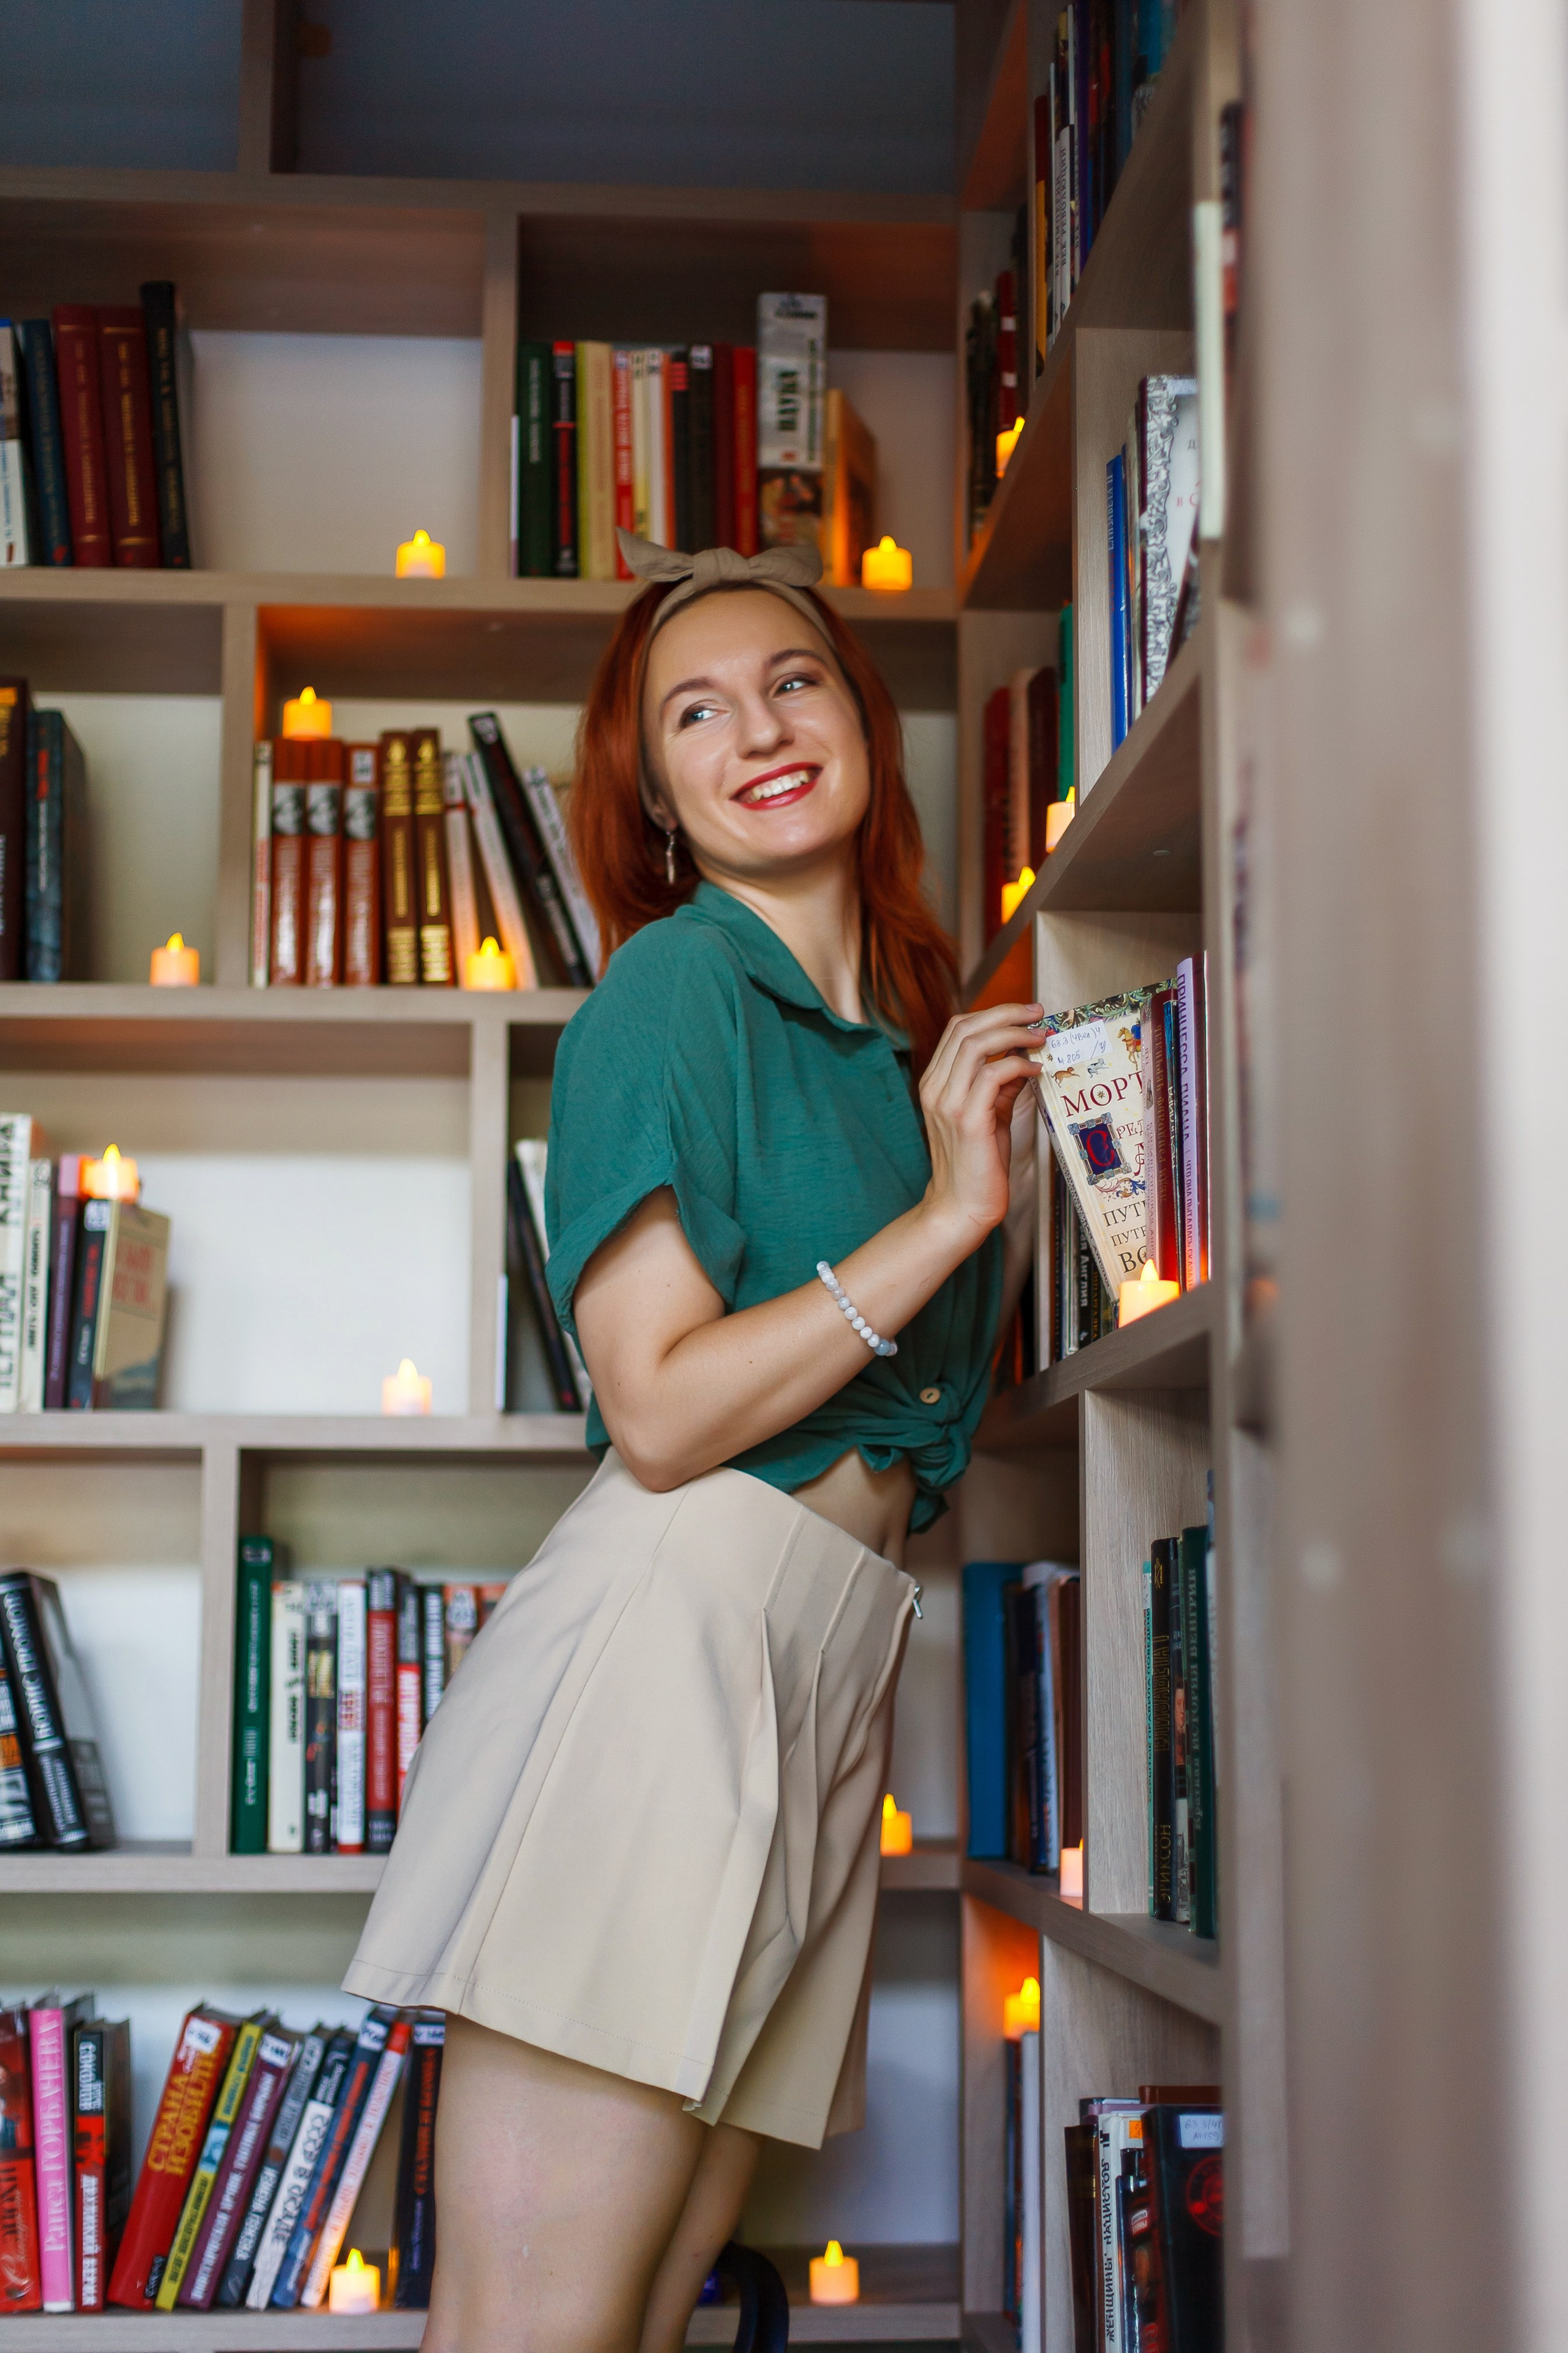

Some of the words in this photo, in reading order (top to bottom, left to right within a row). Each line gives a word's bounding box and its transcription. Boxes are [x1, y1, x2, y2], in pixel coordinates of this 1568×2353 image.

[1067, 1050, 1080, 1063] 805
[1102, 1200, 1146, 1228] ПУТ
[1159, 1823, 1171, 1903] ЭРИКСОН
[164, 2050, 215, 2175] ИЗОБИЛИ
